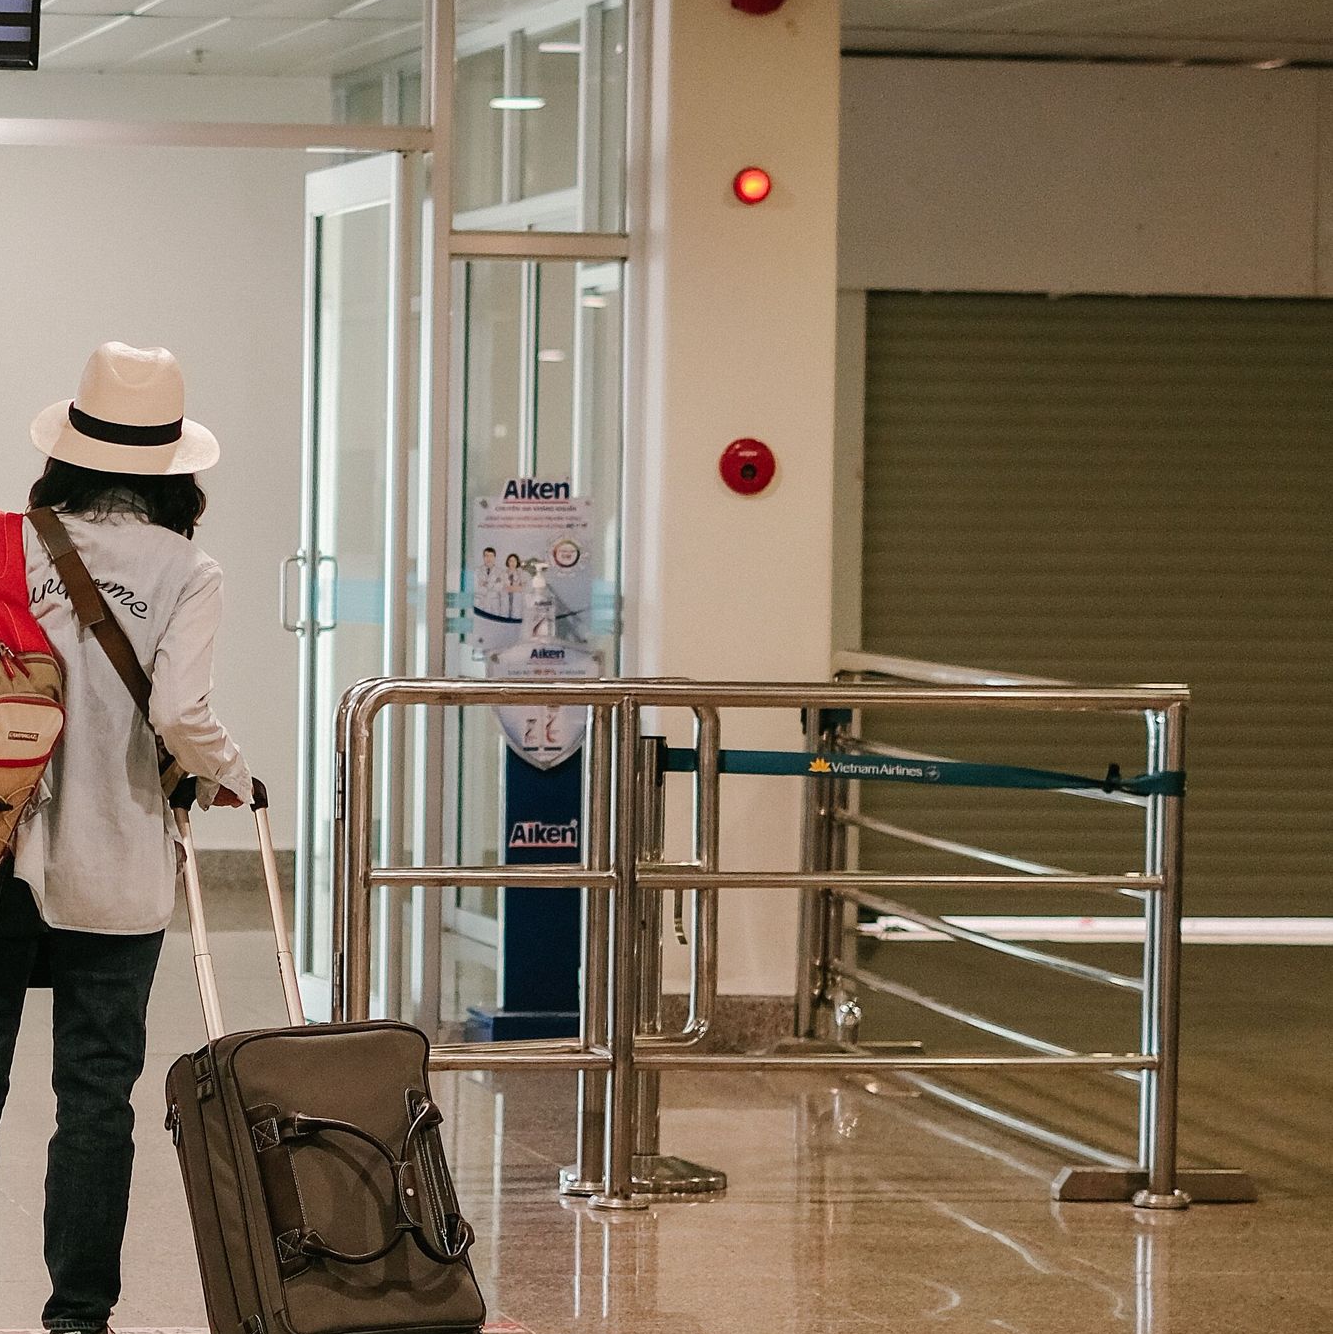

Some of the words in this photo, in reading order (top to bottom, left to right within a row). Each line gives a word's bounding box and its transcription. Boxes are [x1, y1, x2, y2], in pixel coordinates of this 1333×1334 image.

[504, 479, 569, 499] Aiken
[530, 648, 565, 659] Aiken
[831, 762, 879, 775] Vietnam
[879, 764, 923, 777] Airlines
[511, 823, 576, 844] Aiken
